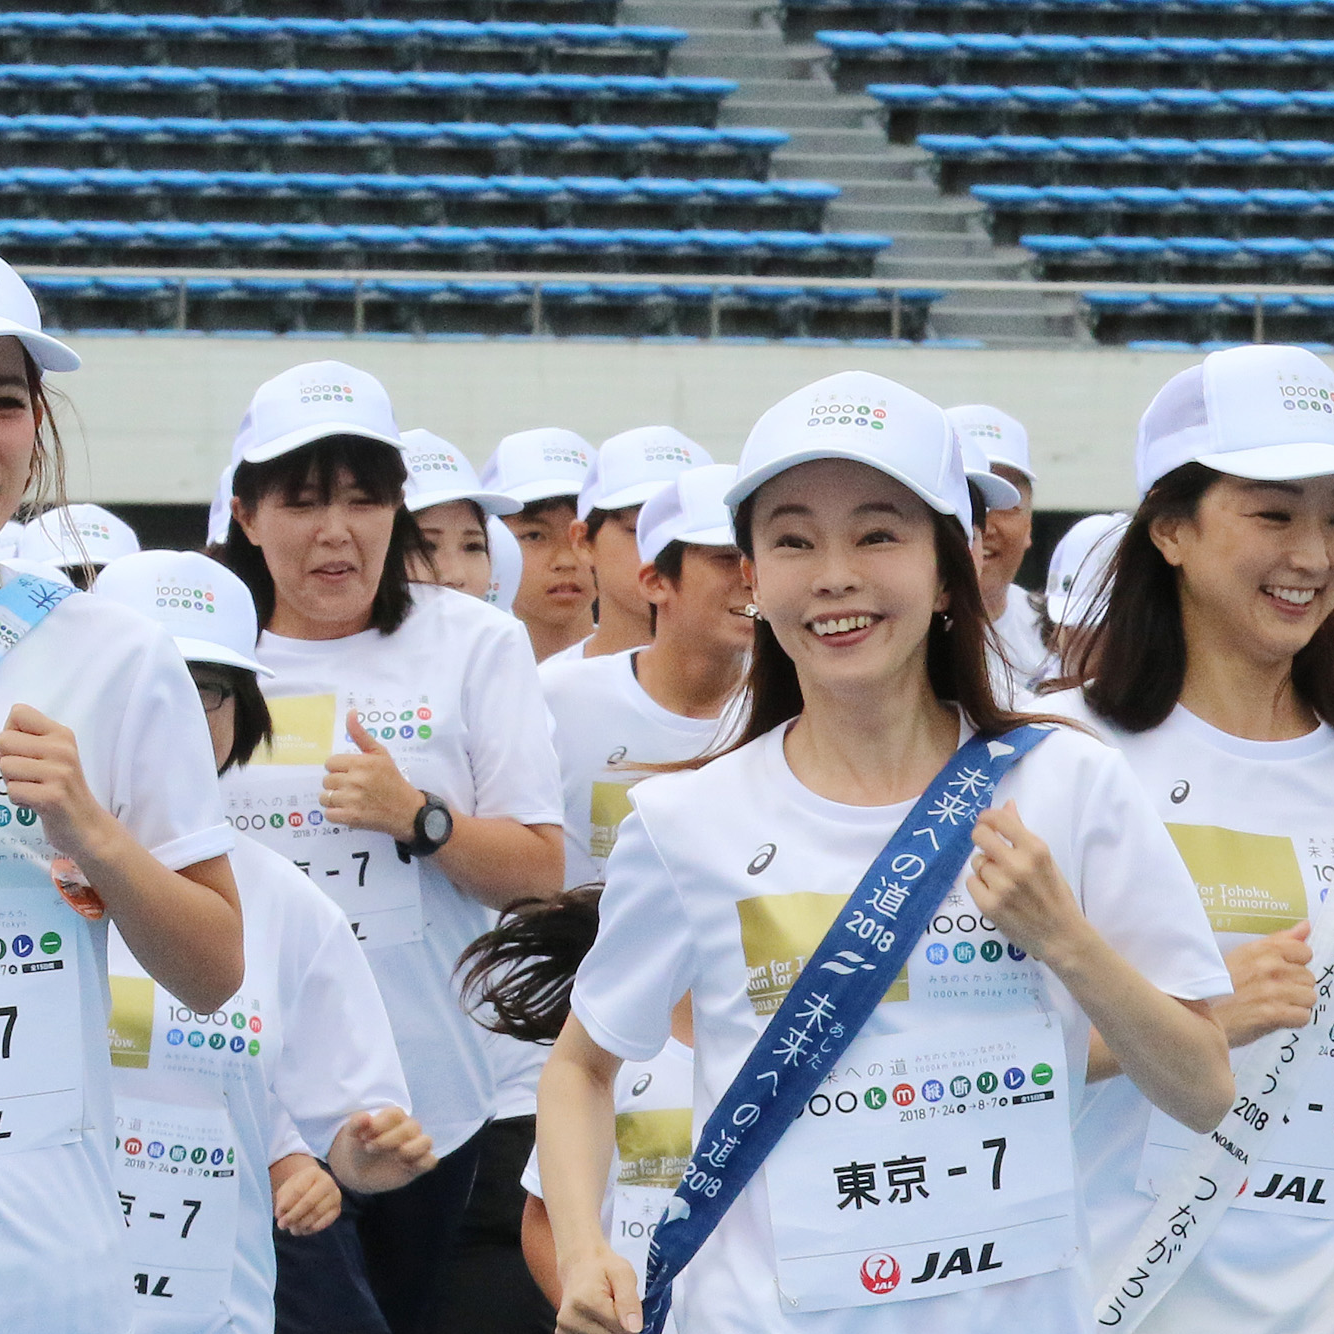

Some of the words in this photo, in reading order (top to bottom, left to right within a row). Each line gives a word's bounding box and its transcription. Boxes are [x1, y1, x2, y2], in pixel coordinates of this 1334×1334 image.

[866, 767, 989, 920] 未来への道
[352, 851, 369, 887] 7
[845, 910, 896, 952] 2018
[899, 1109, 926, 1122] 2018
[1233, 1097, 1269, 1131] 2018
[682, 1161, 723, 1198] 2018
[833, 1155, 930, 1210] 東京
[1254, 1173, 1327, 1204] JAL
[180, 1200, 202, 1239] 7
[911, 1242, 1003, 1284] JAL
